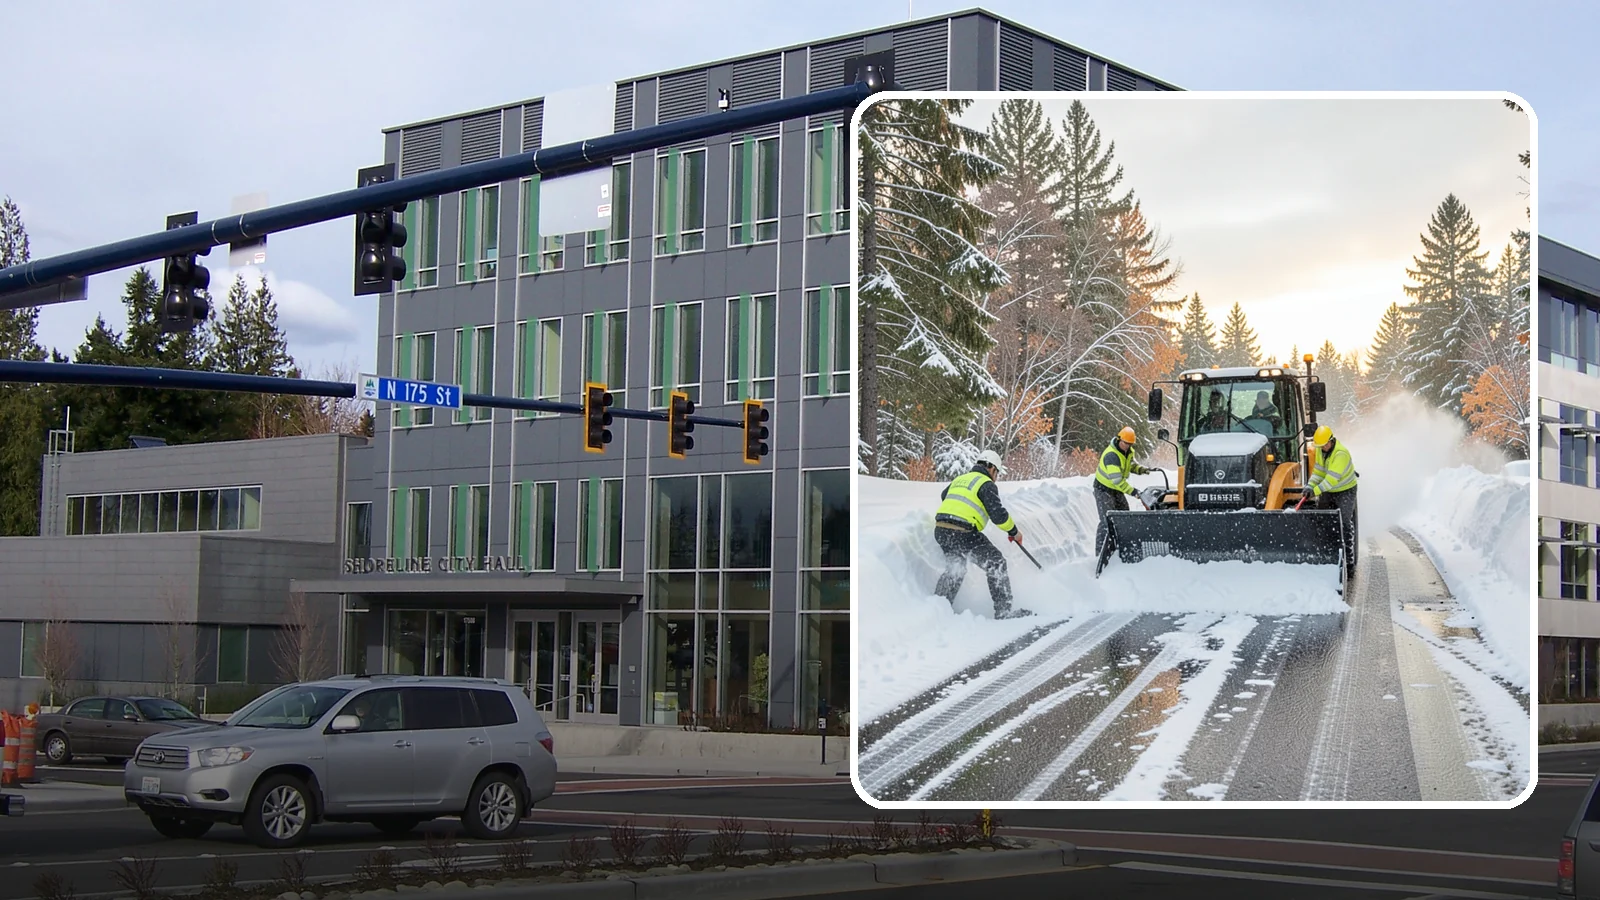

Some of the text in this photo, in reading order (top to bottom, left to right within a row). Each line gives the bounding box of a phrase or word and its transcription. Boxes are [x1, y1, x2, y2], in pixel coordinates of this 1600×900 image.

[387, 380, 452, 406] N 175 St
[344, 555, 525, 573] SHORELINE CITY HALL
